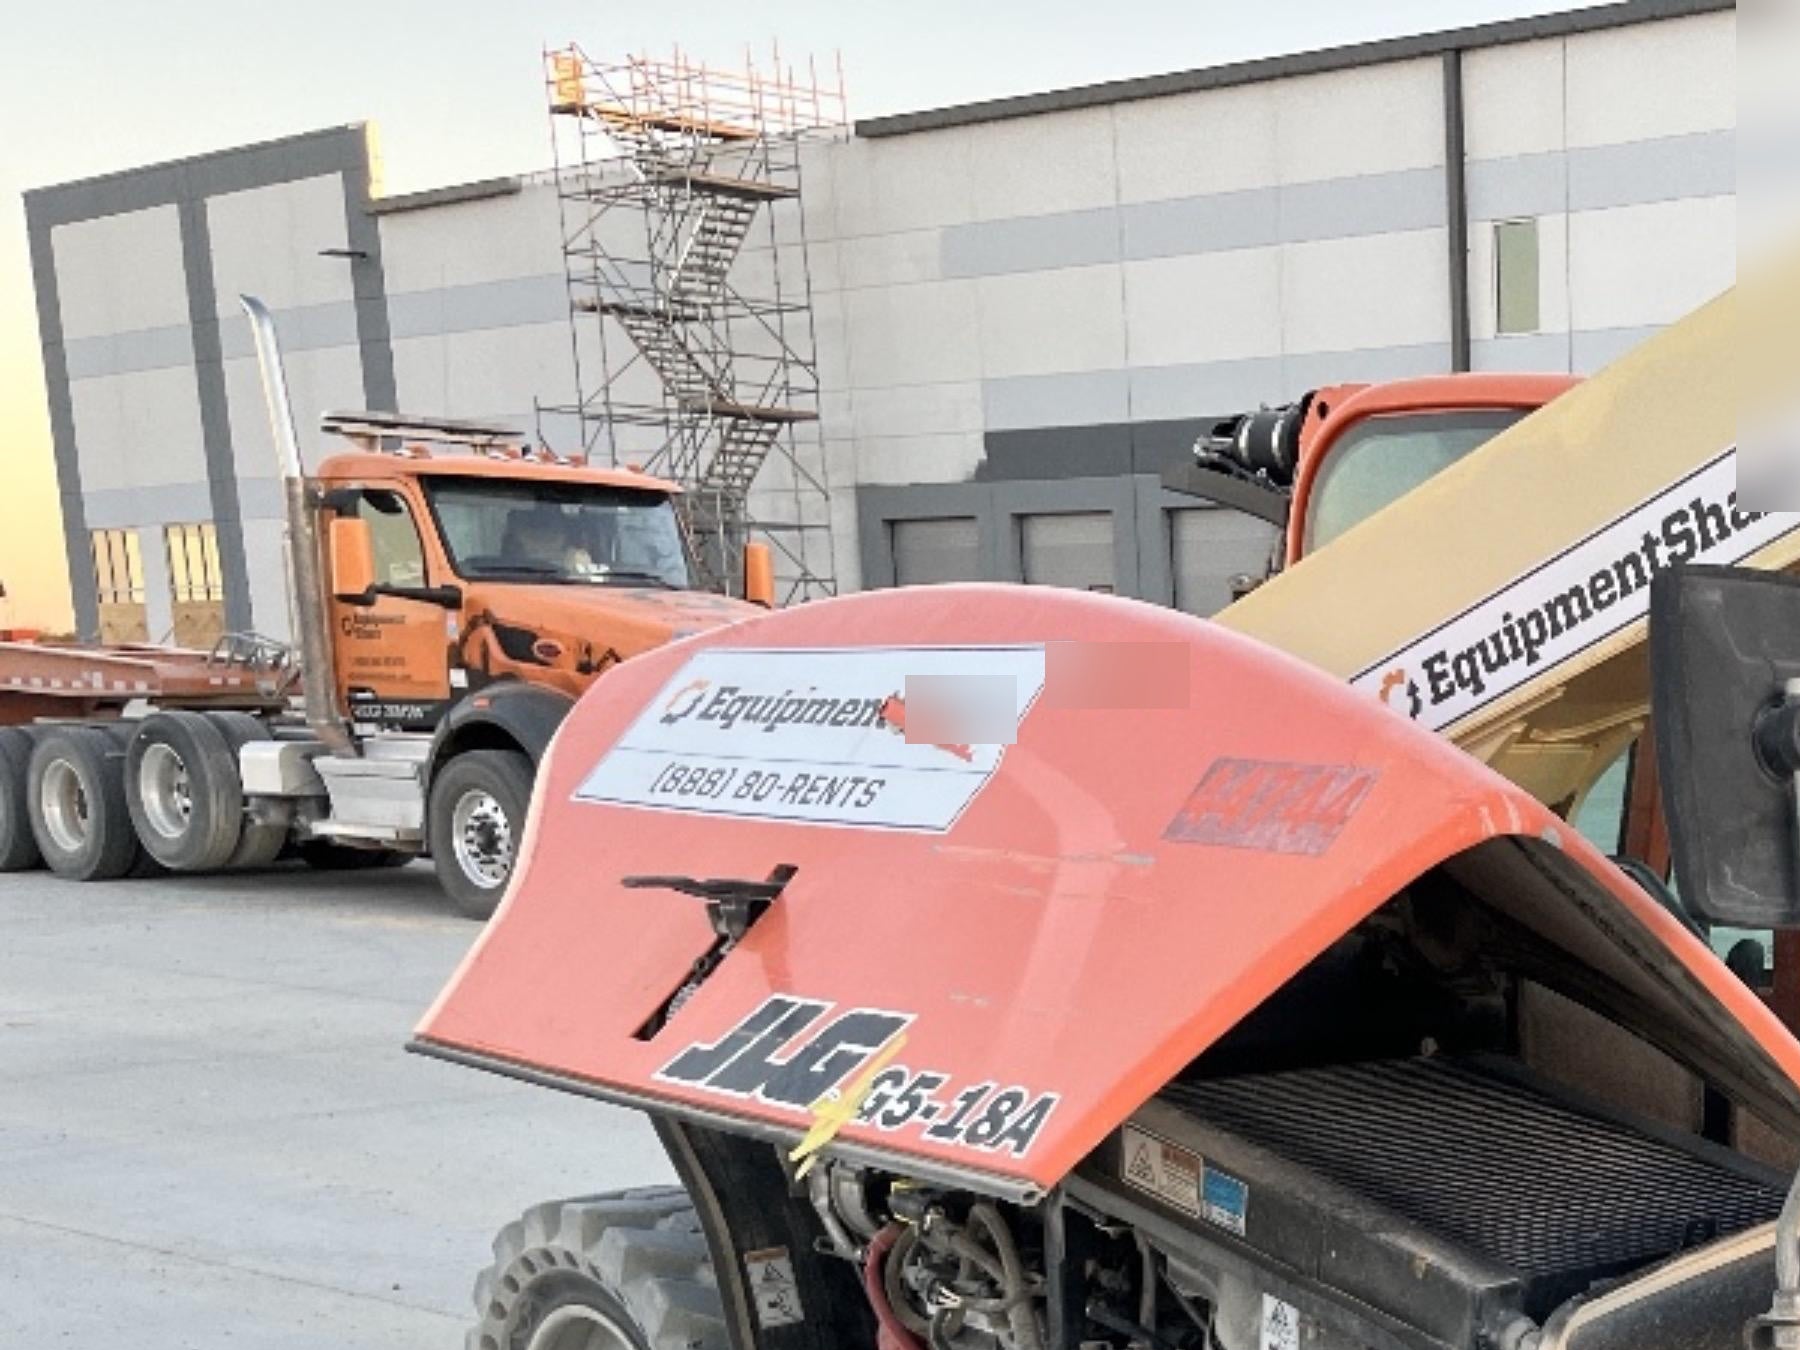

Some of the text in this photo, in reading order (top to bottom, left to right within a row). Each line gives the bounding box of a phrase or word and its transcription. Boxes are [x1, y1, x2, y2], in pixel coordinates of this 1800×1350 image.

[1421, 490, 1772, 706] EquipmentSha
[699, 685, 902, 733] Equipmen
[649, 761, 886, 808] (888) 80-RENTS
[653, 994, 916, 1112] JLG
[857, 1064, 1061, 1159] G5-18A
